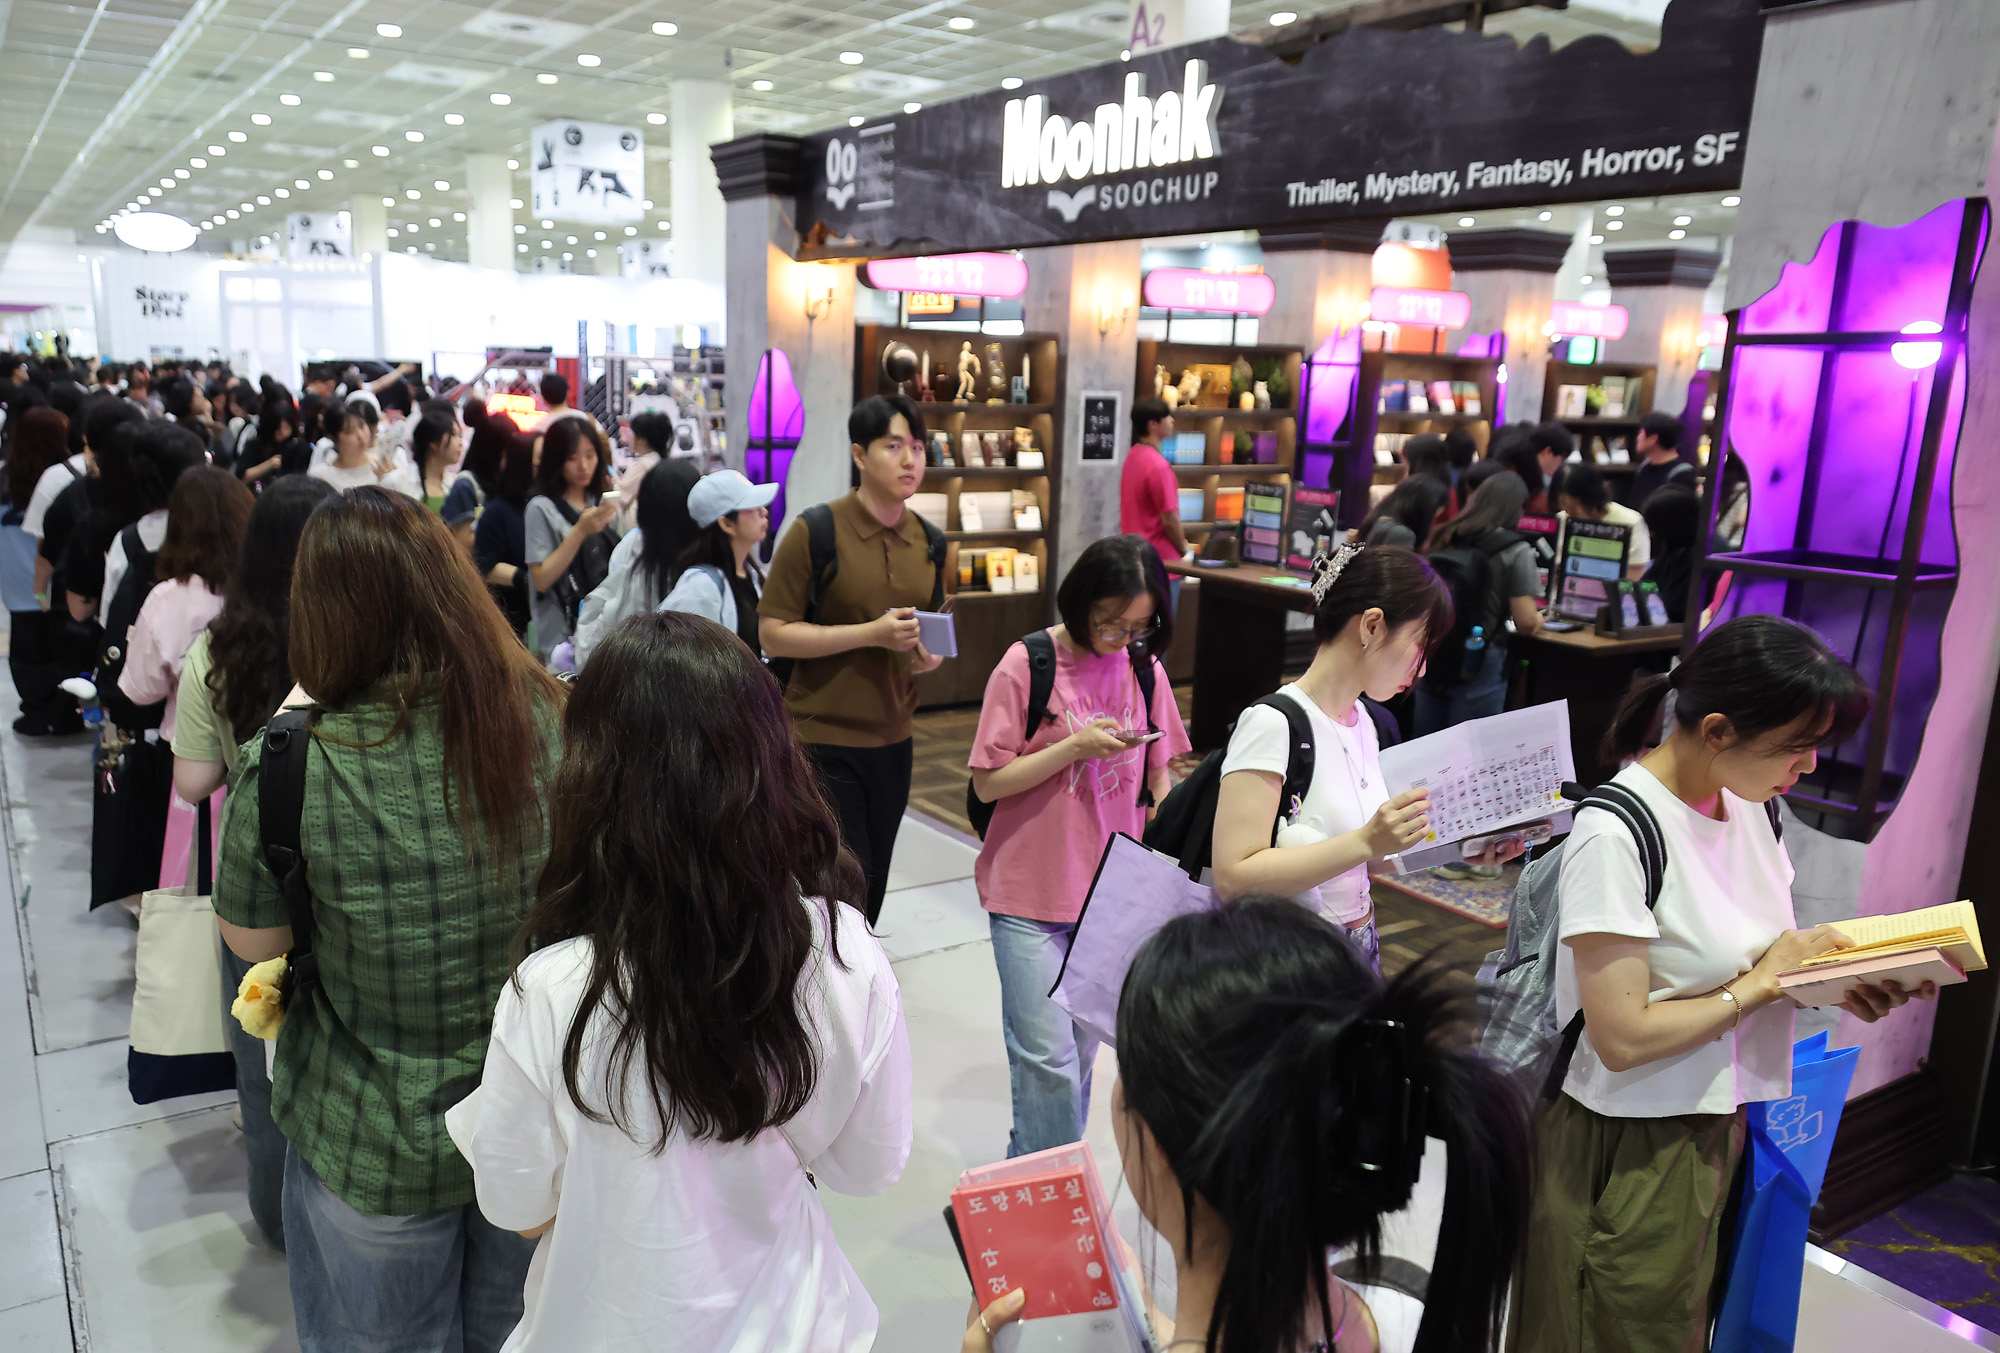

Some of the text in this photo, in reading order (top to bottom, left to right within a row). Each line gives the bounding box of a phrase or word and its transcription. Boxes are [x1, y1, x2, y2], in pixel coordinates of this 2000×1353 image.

[1128, 2, 1166, 50] A2
[1001, 58, 1222, 189] Moonhak
[1099, 170, 1220, 211] SOOCHUP
[1286, 131, 1740, 207] Thriller, Mystery, Fantasy, Horror, SF
